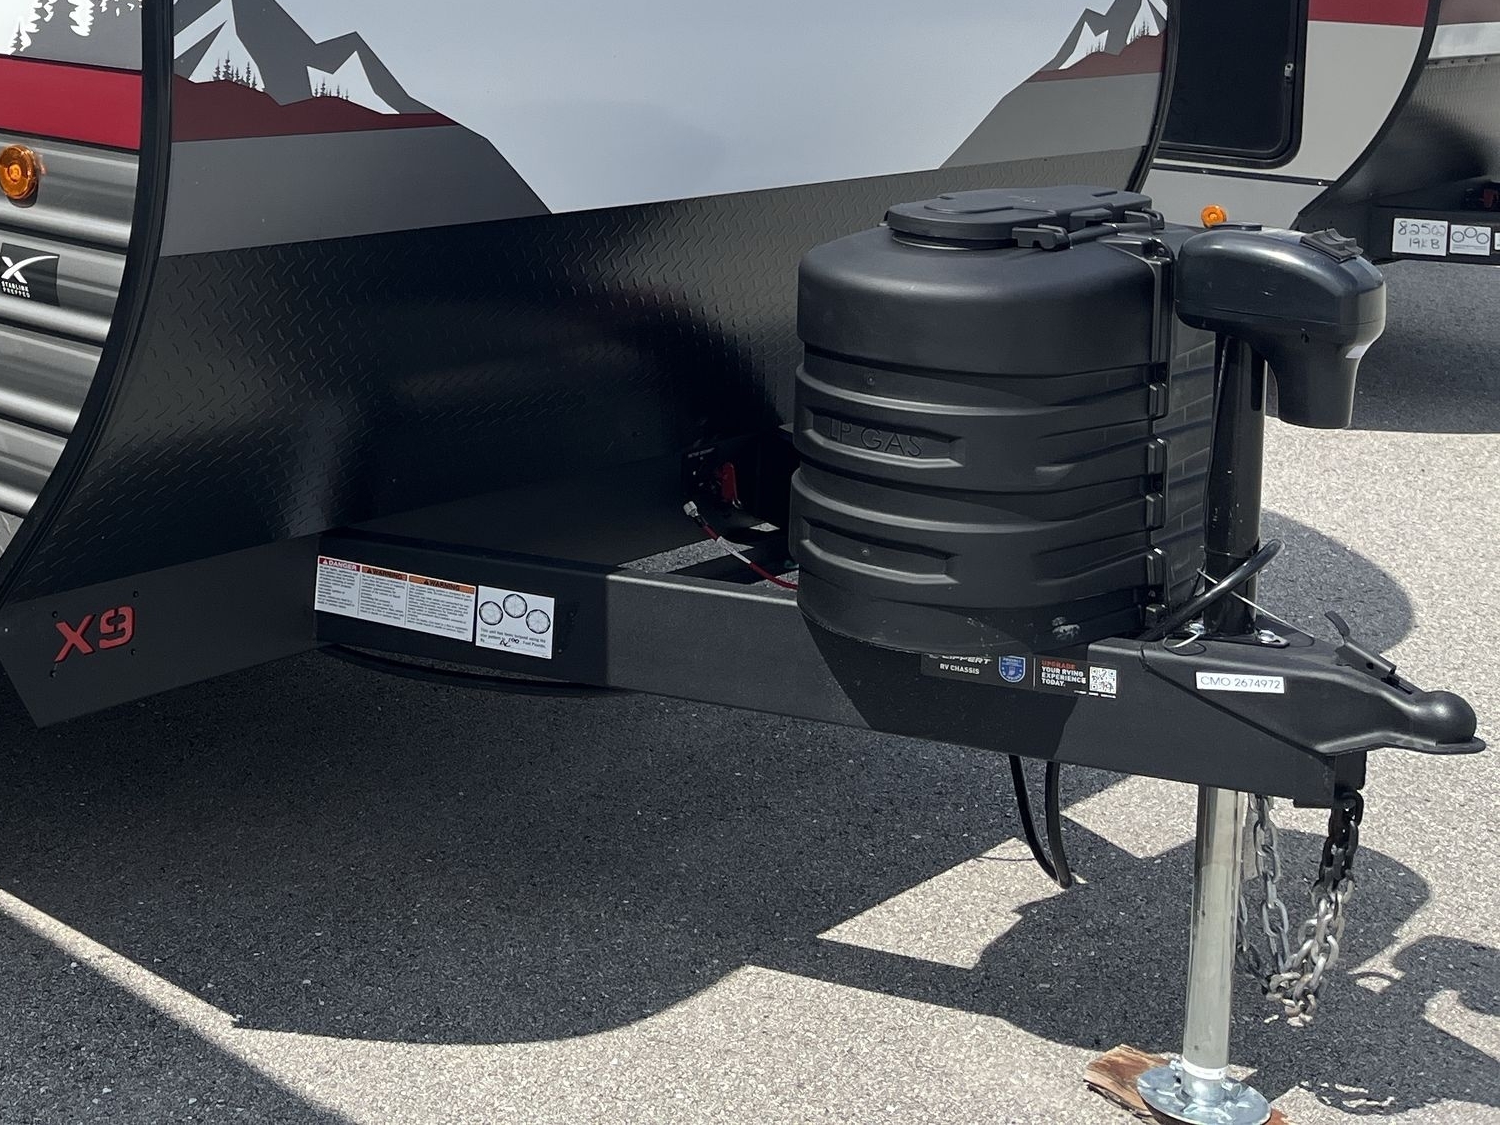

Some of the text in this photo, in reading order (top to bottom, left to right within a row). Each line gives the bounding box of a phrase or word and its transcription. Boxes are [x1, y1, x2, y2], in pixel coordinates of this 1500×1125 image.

[860, 428, 922, 457] GAS
[329, 560, 357, 571] DANGER
[55, 606, 134, 662] X9
[950, 665, 980, 675] CHASSIS
[1041, 660, 1077, 669] UPGRADE
[1041, 666, 1084, 677] YOUR RVING
[1041, 672, 1087, 684] EXPERIENCE
[1200, 676, 1281, 689] CMO 2674972
